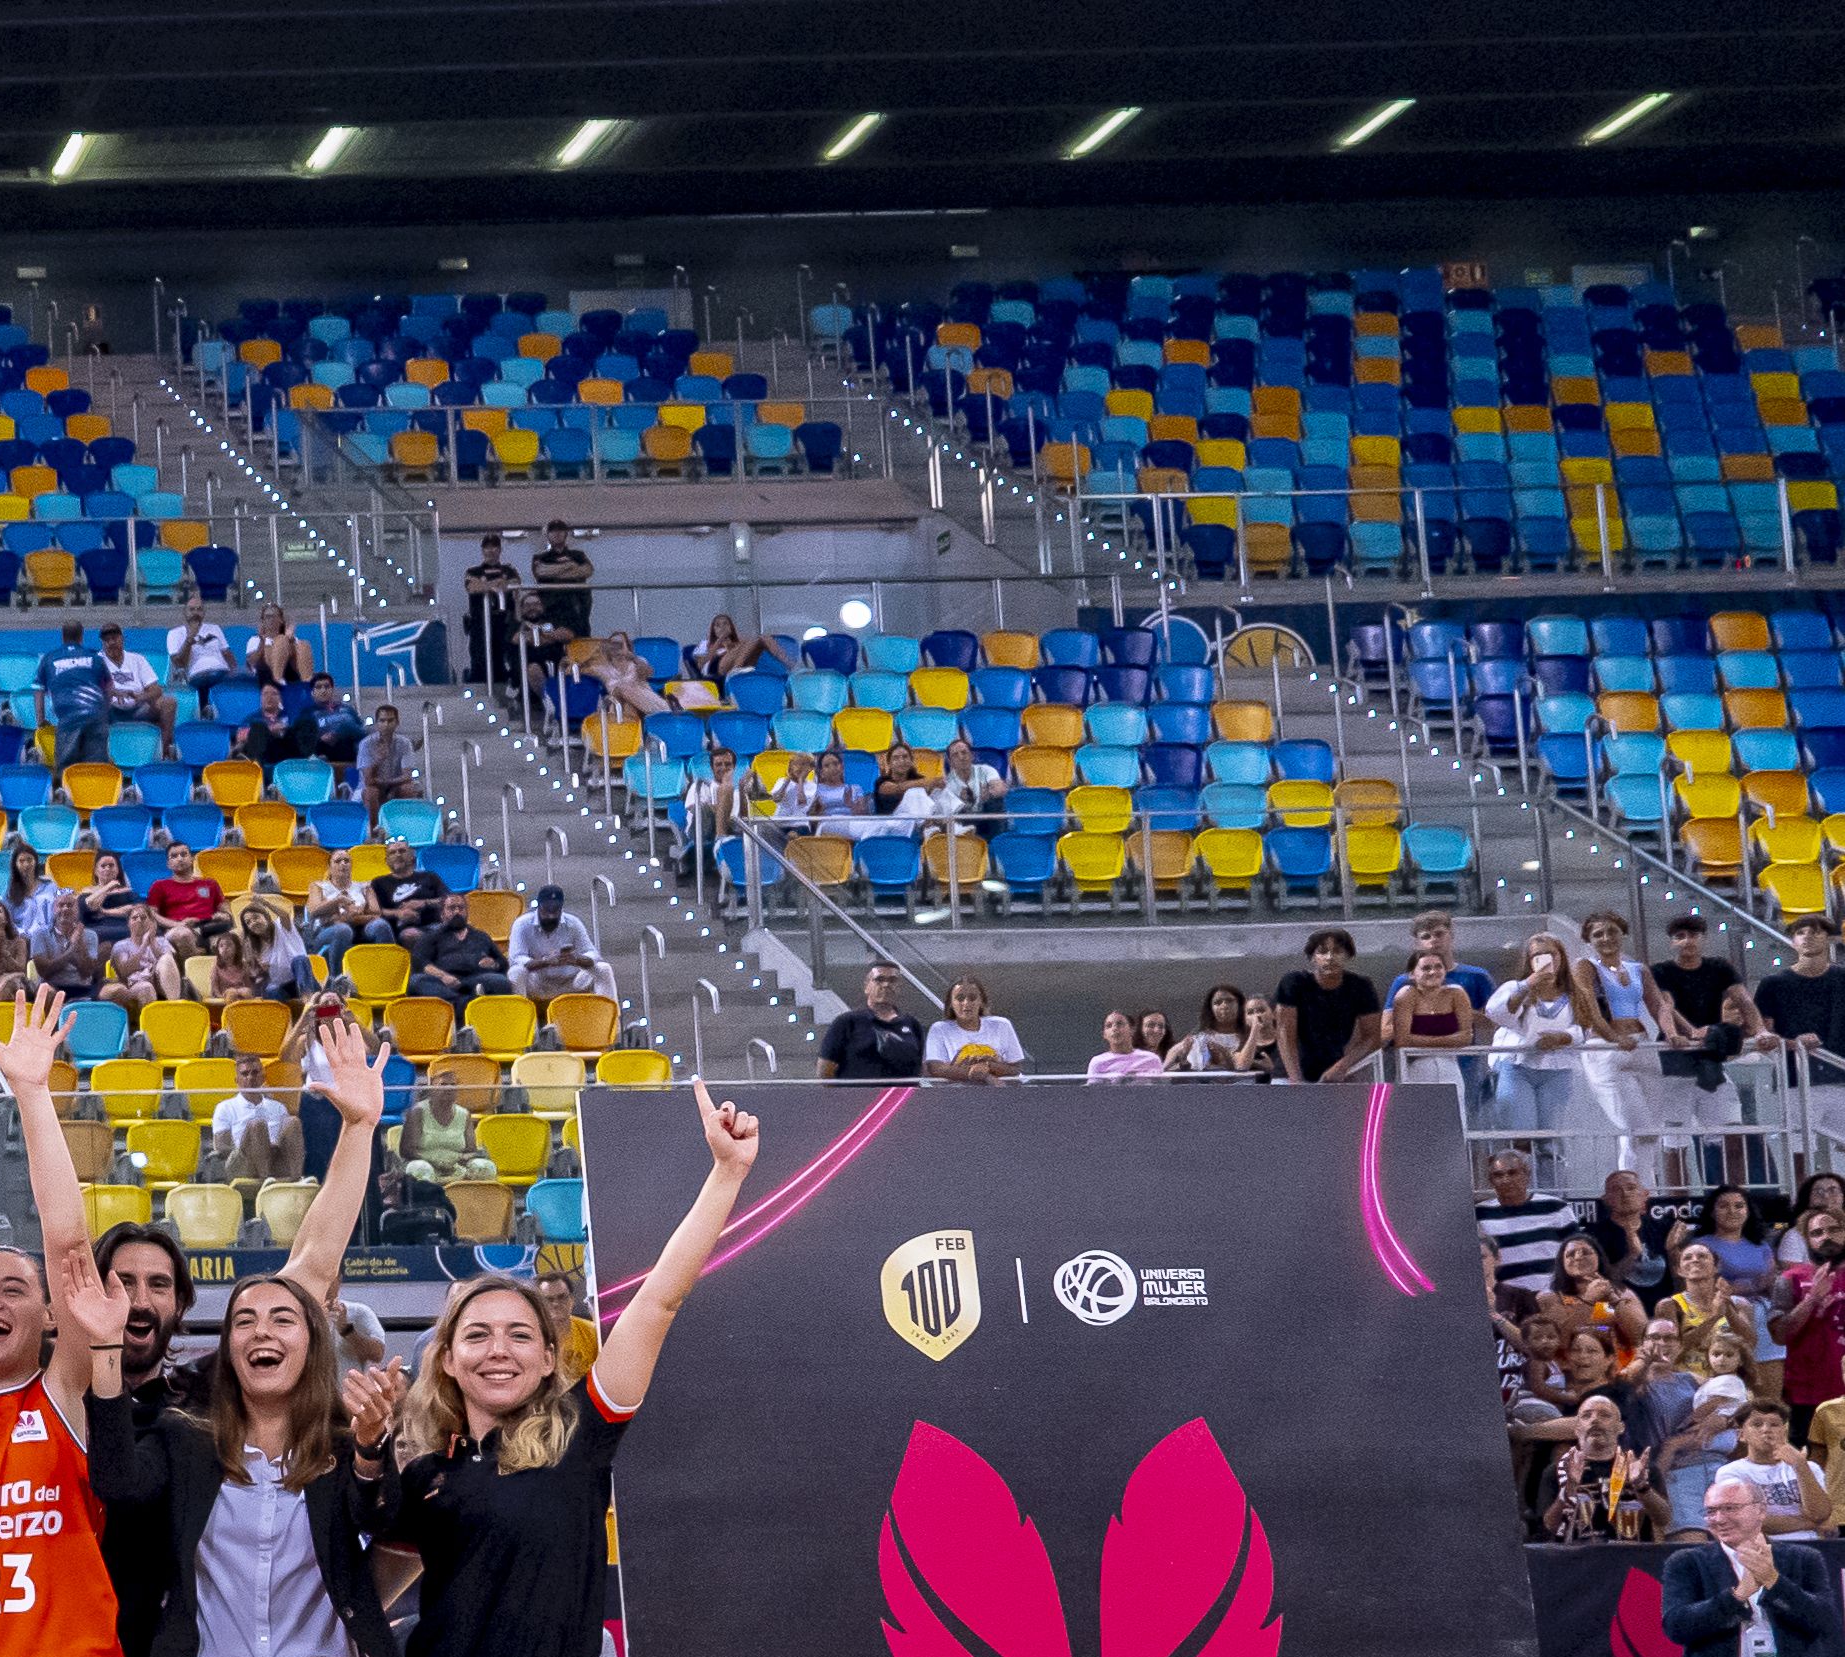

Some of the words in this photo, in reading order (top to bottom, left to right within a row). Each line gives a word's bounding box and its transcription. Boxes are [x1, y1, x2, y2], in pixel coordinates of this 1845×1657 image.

[935, 1237, 966, 1251] FEB
[1140, 1268, 1205, 1280] UNIVERSO
[1142, 1280, 1207, 1295] MUJER
[34, 1484, 60, 1501] del
